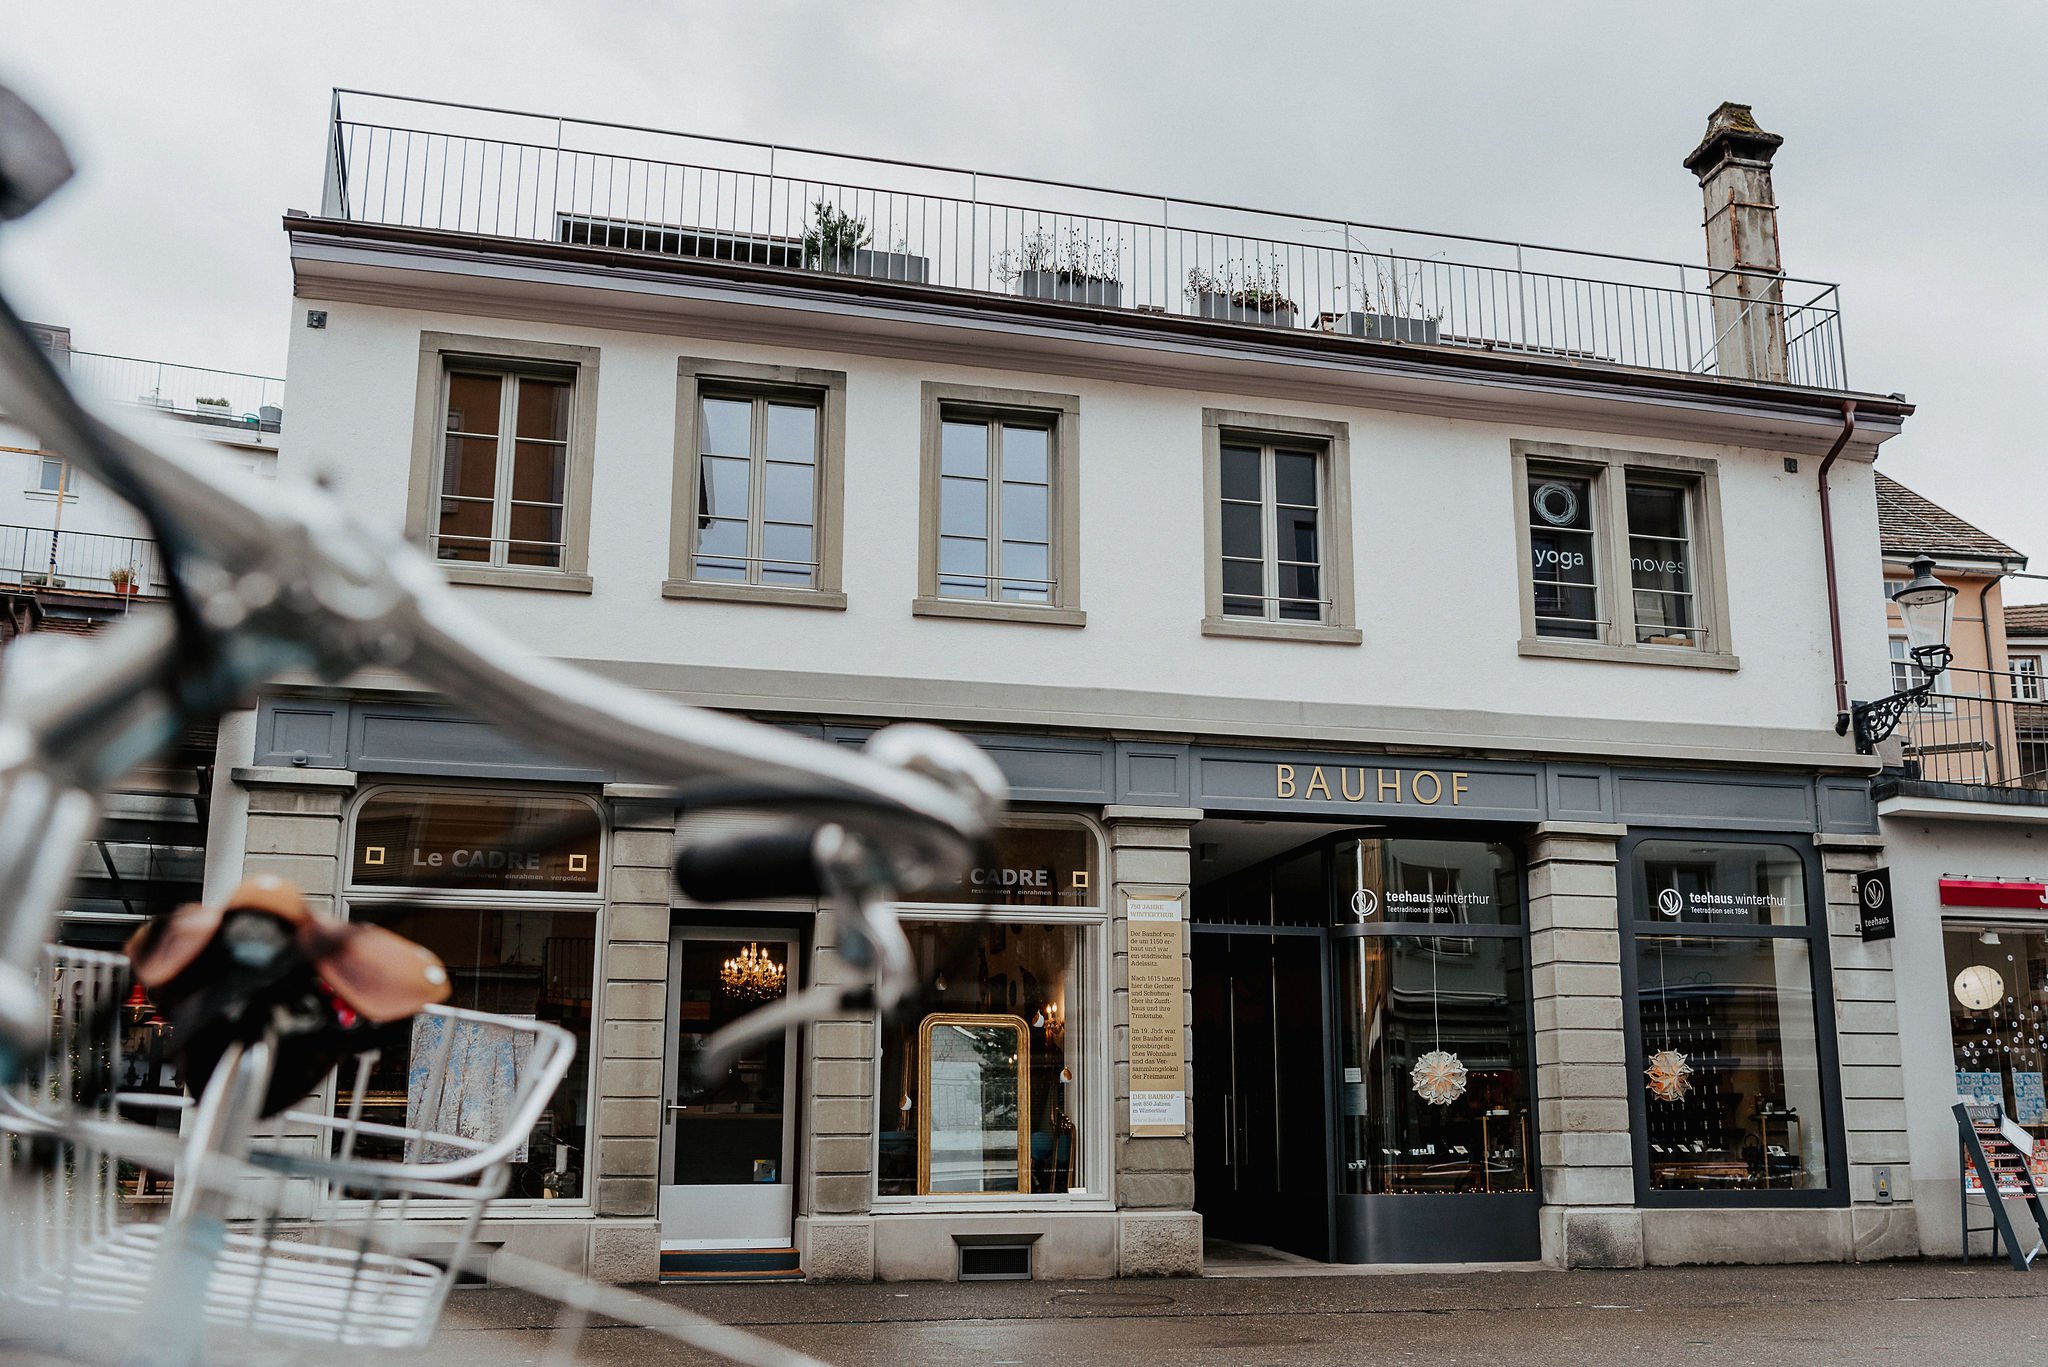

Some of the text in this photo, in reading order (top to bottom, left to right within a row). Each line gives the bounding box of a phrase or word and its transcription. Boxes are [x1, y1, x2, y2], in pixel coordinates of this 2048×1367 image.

[1534, 548, 1584, 570] yoga
[1277, 764, 1469, 806] BAUHOF
[413, 848, 540, 870] Le CADRE
[550, 874, 586, 882] vergolden
[970, 868, 1048, 887] CADRE
[1386, 890, 1489, 905] teehaus.winterthur
[1689, 891, 1787, 906] teehaus.winterthur
[1386, 905, 1421, 913] Teetradition
[1691, 906, 1722, 914] Teetradition
[1865, 916, 1890, 927] teehaus
